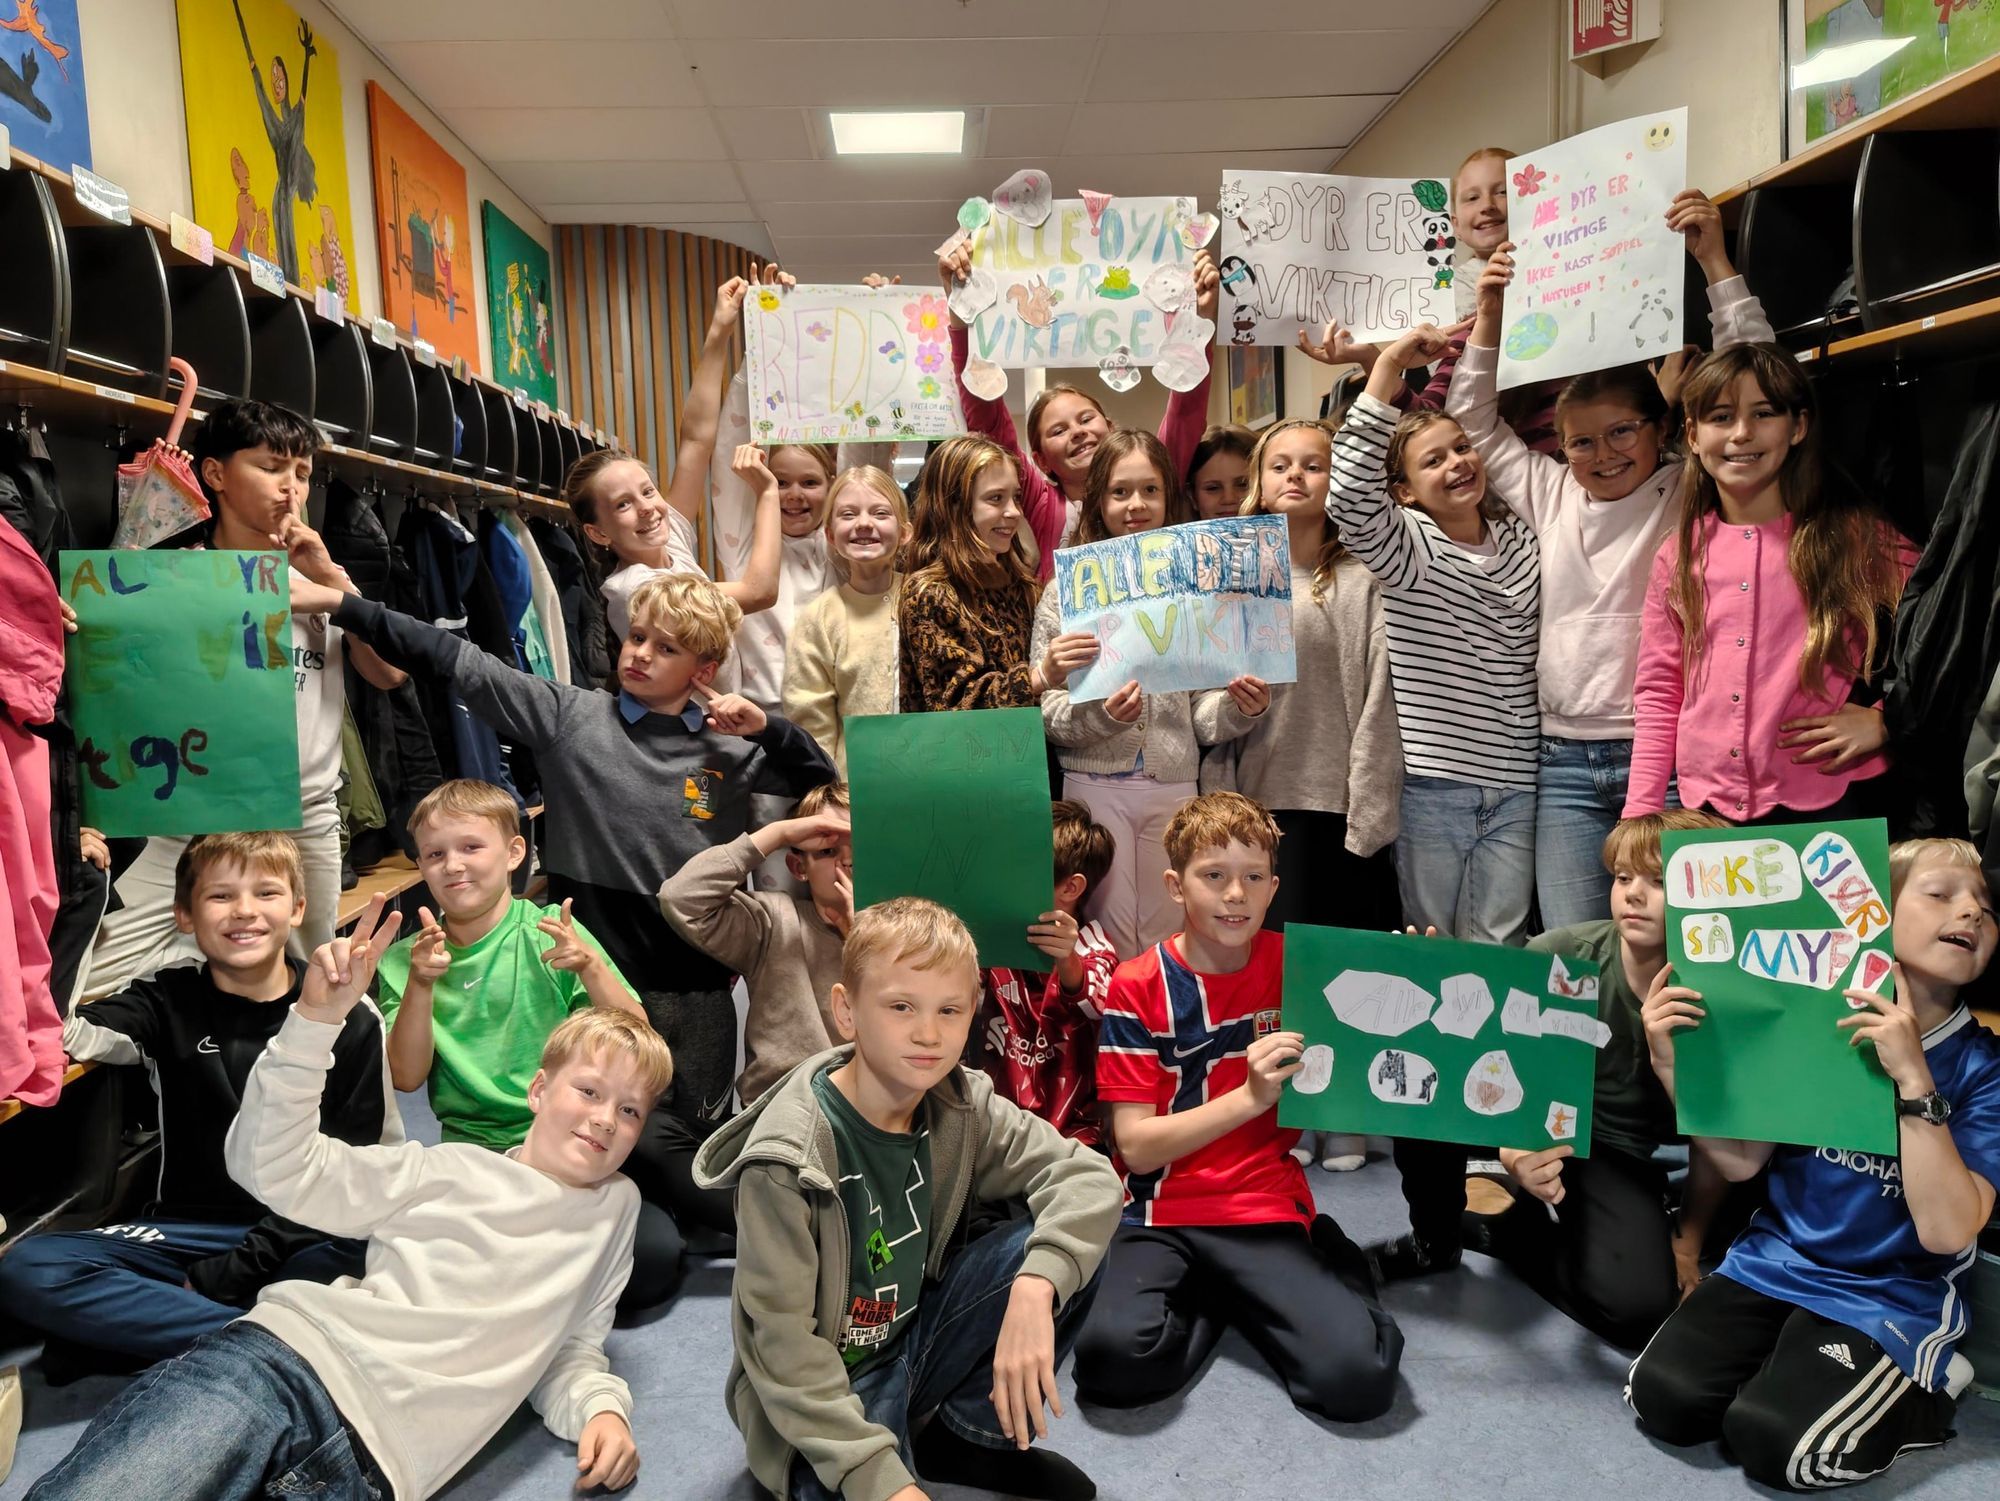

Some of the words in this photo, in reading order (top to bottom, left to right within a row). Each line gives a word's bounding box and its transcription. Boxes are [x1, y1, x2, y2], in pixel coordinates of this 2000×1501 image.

[1570, 184, 1597, 212] DYR
[1608, 174, 1629, 197] ER
[972, 206, 1084, 271] ALLE
[1267, 182, 1350, 252] DYR
[1366, 192, 1427, 254] ER
[1543, 216, 1607, 249] VIKTIGE
[1526, 265, 1557, 286] IKKE
[1564, 254, 1594, 273] KAST
[1253, 263, 1440, 331] VIKTIGE
[976, 309, 1154, 362] VIKTIGE
[759, 306, 907, 420] REDD
[211, 553, 282, 596] DYR
[1073, 533, 1178, 610] ALLE
[1684, 843, 1784, 900] IKKE
[1807, 838, 1889, 938] KJØR
[1687, 915, 1729, 956] SÅ
[1742, 930, 1854, 985] MYE
[1342, 979, 1426, 1029] Alle
[852, 1307, 892, 1323] MOBS
[861, 1300, 878, 1311] THE
[850, 1328, 874, 1338] COME
[875, 1323, 888, 1334] OUT
[850, 1337, 861, 1346] AT
[864, 1331, 887, 1345] NIGHT
[1818, 1346, 1856, 1371] adidas
